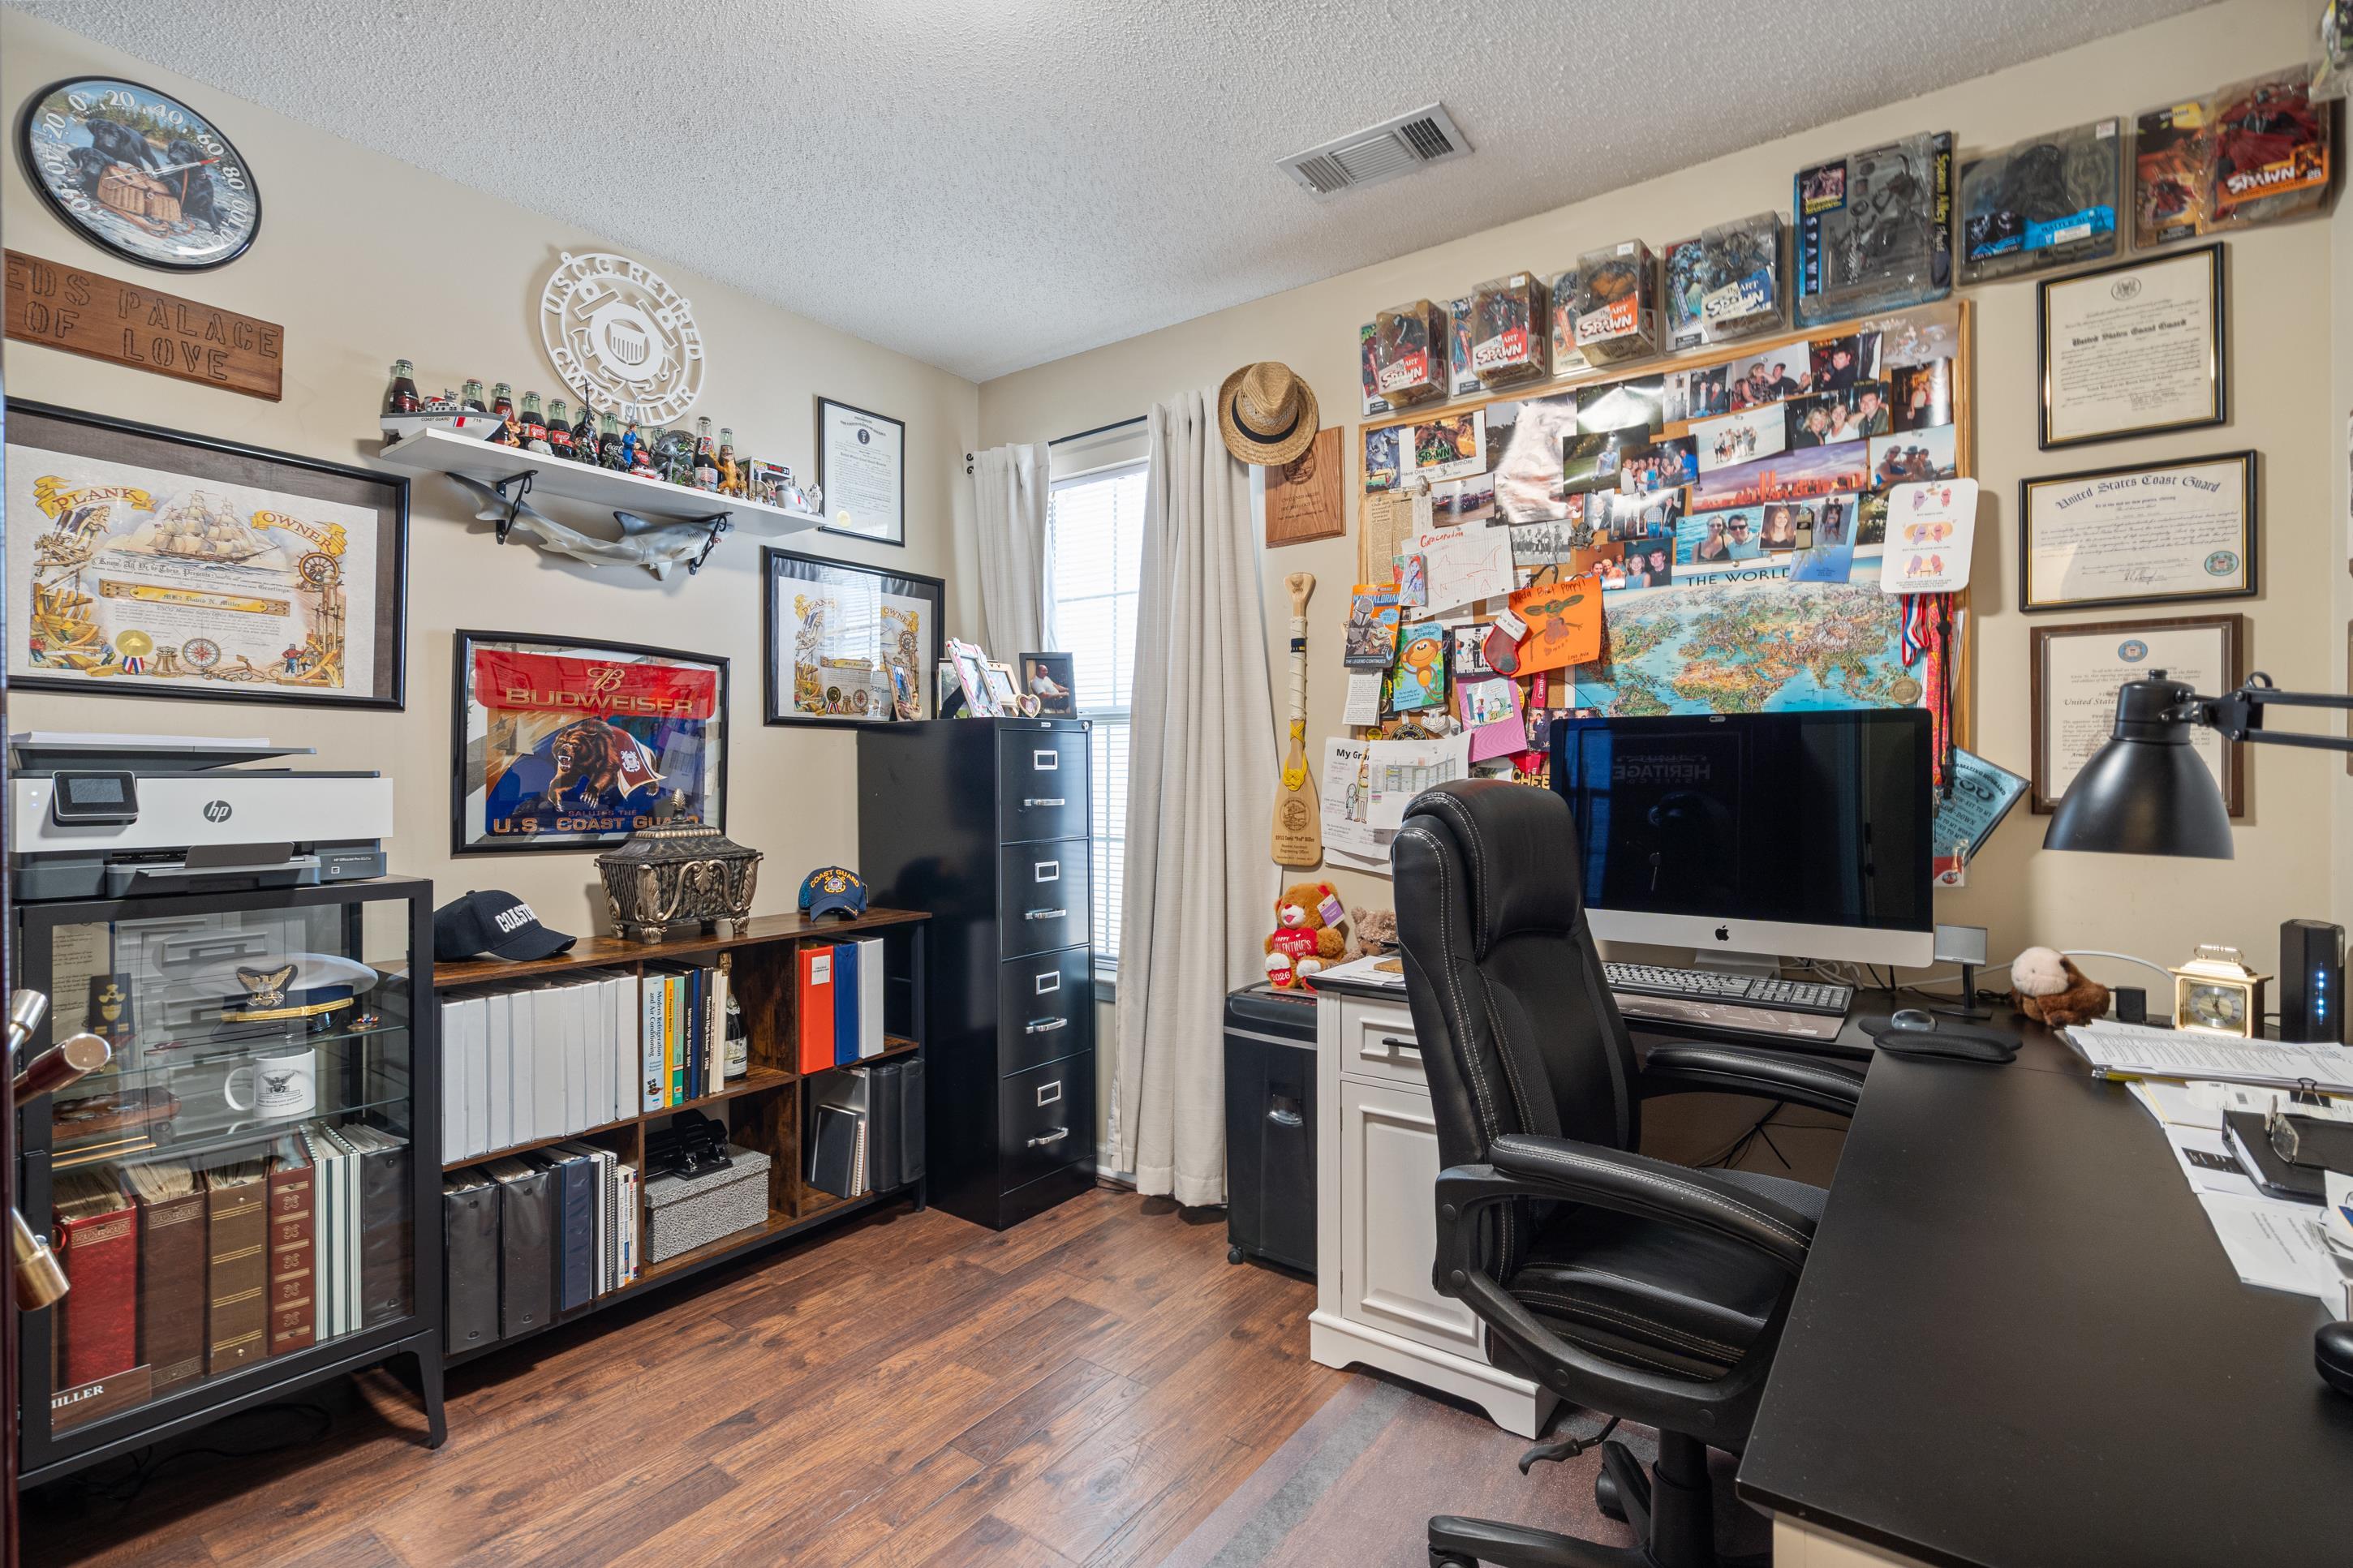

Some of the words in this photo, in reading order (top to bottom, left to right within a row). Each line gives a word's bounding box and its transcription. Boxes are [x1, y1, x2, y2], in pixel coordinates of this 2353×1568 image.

[105, 90, 136, 107] 20
[152, 104, 183, 125] 40
[196, 134, 225, 157] 60
[222, 167, 246, 191] 80
[2226, 166, 2295, 195] SPAWN
[1740, 280, 1759, 291] ART
[629, 260, 703, 362] RETIRED
[1611, 303, 1628, 315] ART
[1706, 290, 1764, 318] SPAWN
[118, 288, 279, 359] PALACE
[1580, 312, 1632, 339] SPAWN
[24, 301, 79, 339] OF
[123, 329, 229, 381] LOVE
[1503, 331, 1519, 343] ART
[1476, 342, 1522, 365] SPAWN
[1417, 448, 1451, 463] SPAWN
[52, 488, 143, 511] PLANK
[2055, 488, 2093, 509] United
[2098, 478, 2137, 493] States
[2141, 475, 2179, 486] Coast
[2182, 475, 2221, 493] Guard
[262, 512, 337, 556] OWNER
[1686, 574, 1722, 586] THE
[1512, 591, 1532, 605] Yoda
[883, 607, 914, 629] OWNER
[505, 688, 694, 715] BUDWEISER
[1336, 748, 1351, 760] My
[618, 809, 637, 817] THE
[493, 818, 545, 835] U.S.
[556, 814, 624, 832] COAST
[632, 814, 699, 829] GUAD
[810, 869, 834, 888] COAST
[836, 869, 859, 888] GUARD
